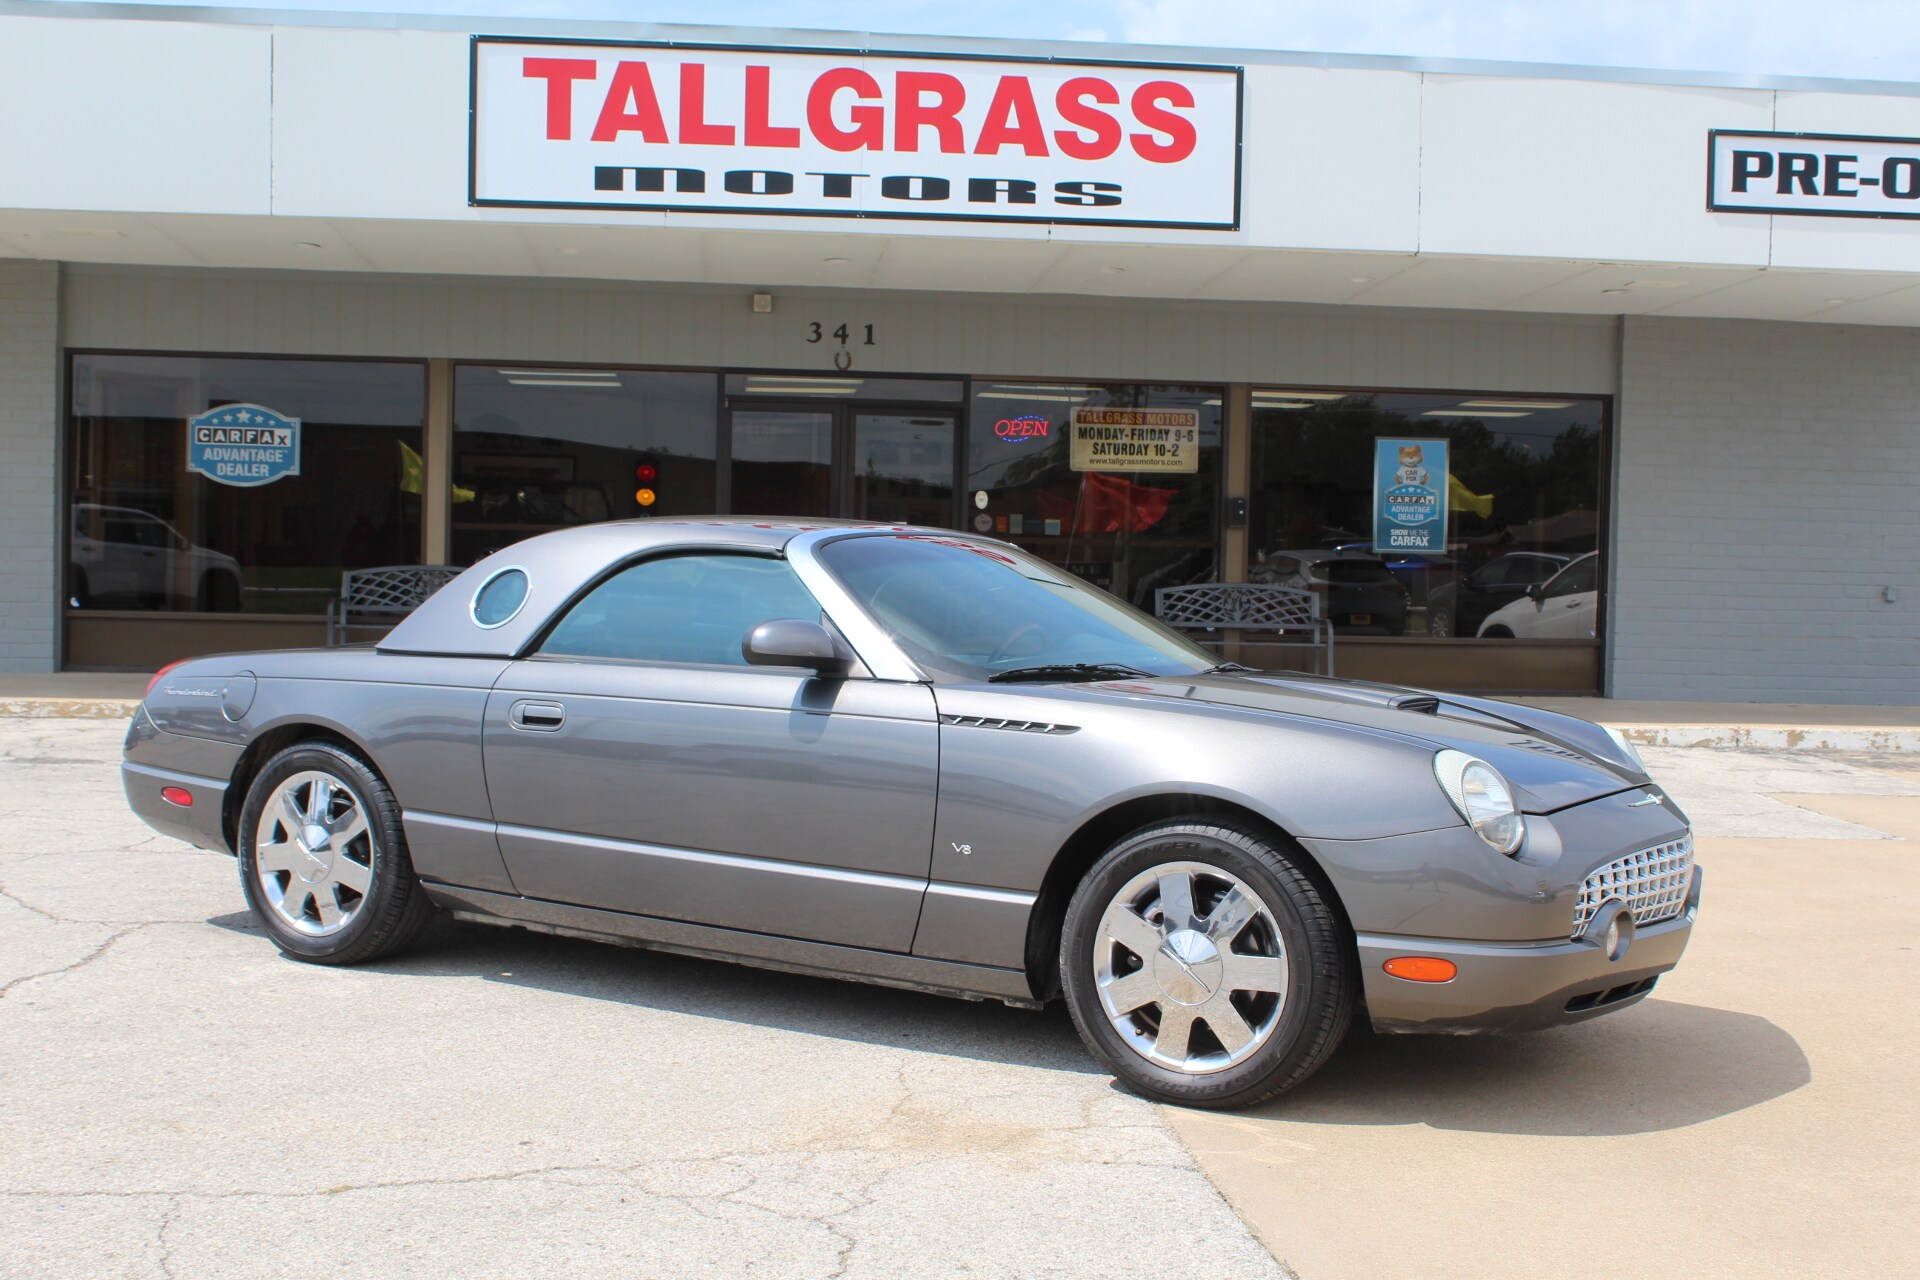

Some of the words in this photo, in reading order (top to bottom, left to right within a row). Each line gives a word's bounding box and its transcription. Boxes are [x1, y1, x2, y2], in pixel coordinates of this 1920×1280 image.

[522, 57, 1198, 164] TALLGRASS
[806, 321, 876, 345] 341
[1079, 411, 1144, 425] TALLGRASS
[1147, 413, 1193, 425] MOTORS
[995, 419, 1049, 436] OPEN
[1078, 427, 1170, 441] MONDAY-FRIDAY
[1174, 429, 1194, 442] 9-6
[197, 428, 290, 446] CARFAX
[203, 447, 284, 463] ADVANTAGE
[1093, 442, 1149, 456] SATURDAY
[1154, 443, 1180, 457] 10-2
[1089, 457, 1183, 466] www.tallgrassmotors.com
[216, 463, 269, 477] DEALER
[1389, 495, 1434, 504] CARFAX
[1391, 505, 1431, 513] ADVANTAGE
[1390, 536, 1429, 547] CARFAX
[951, 842, 972, 855] V8
